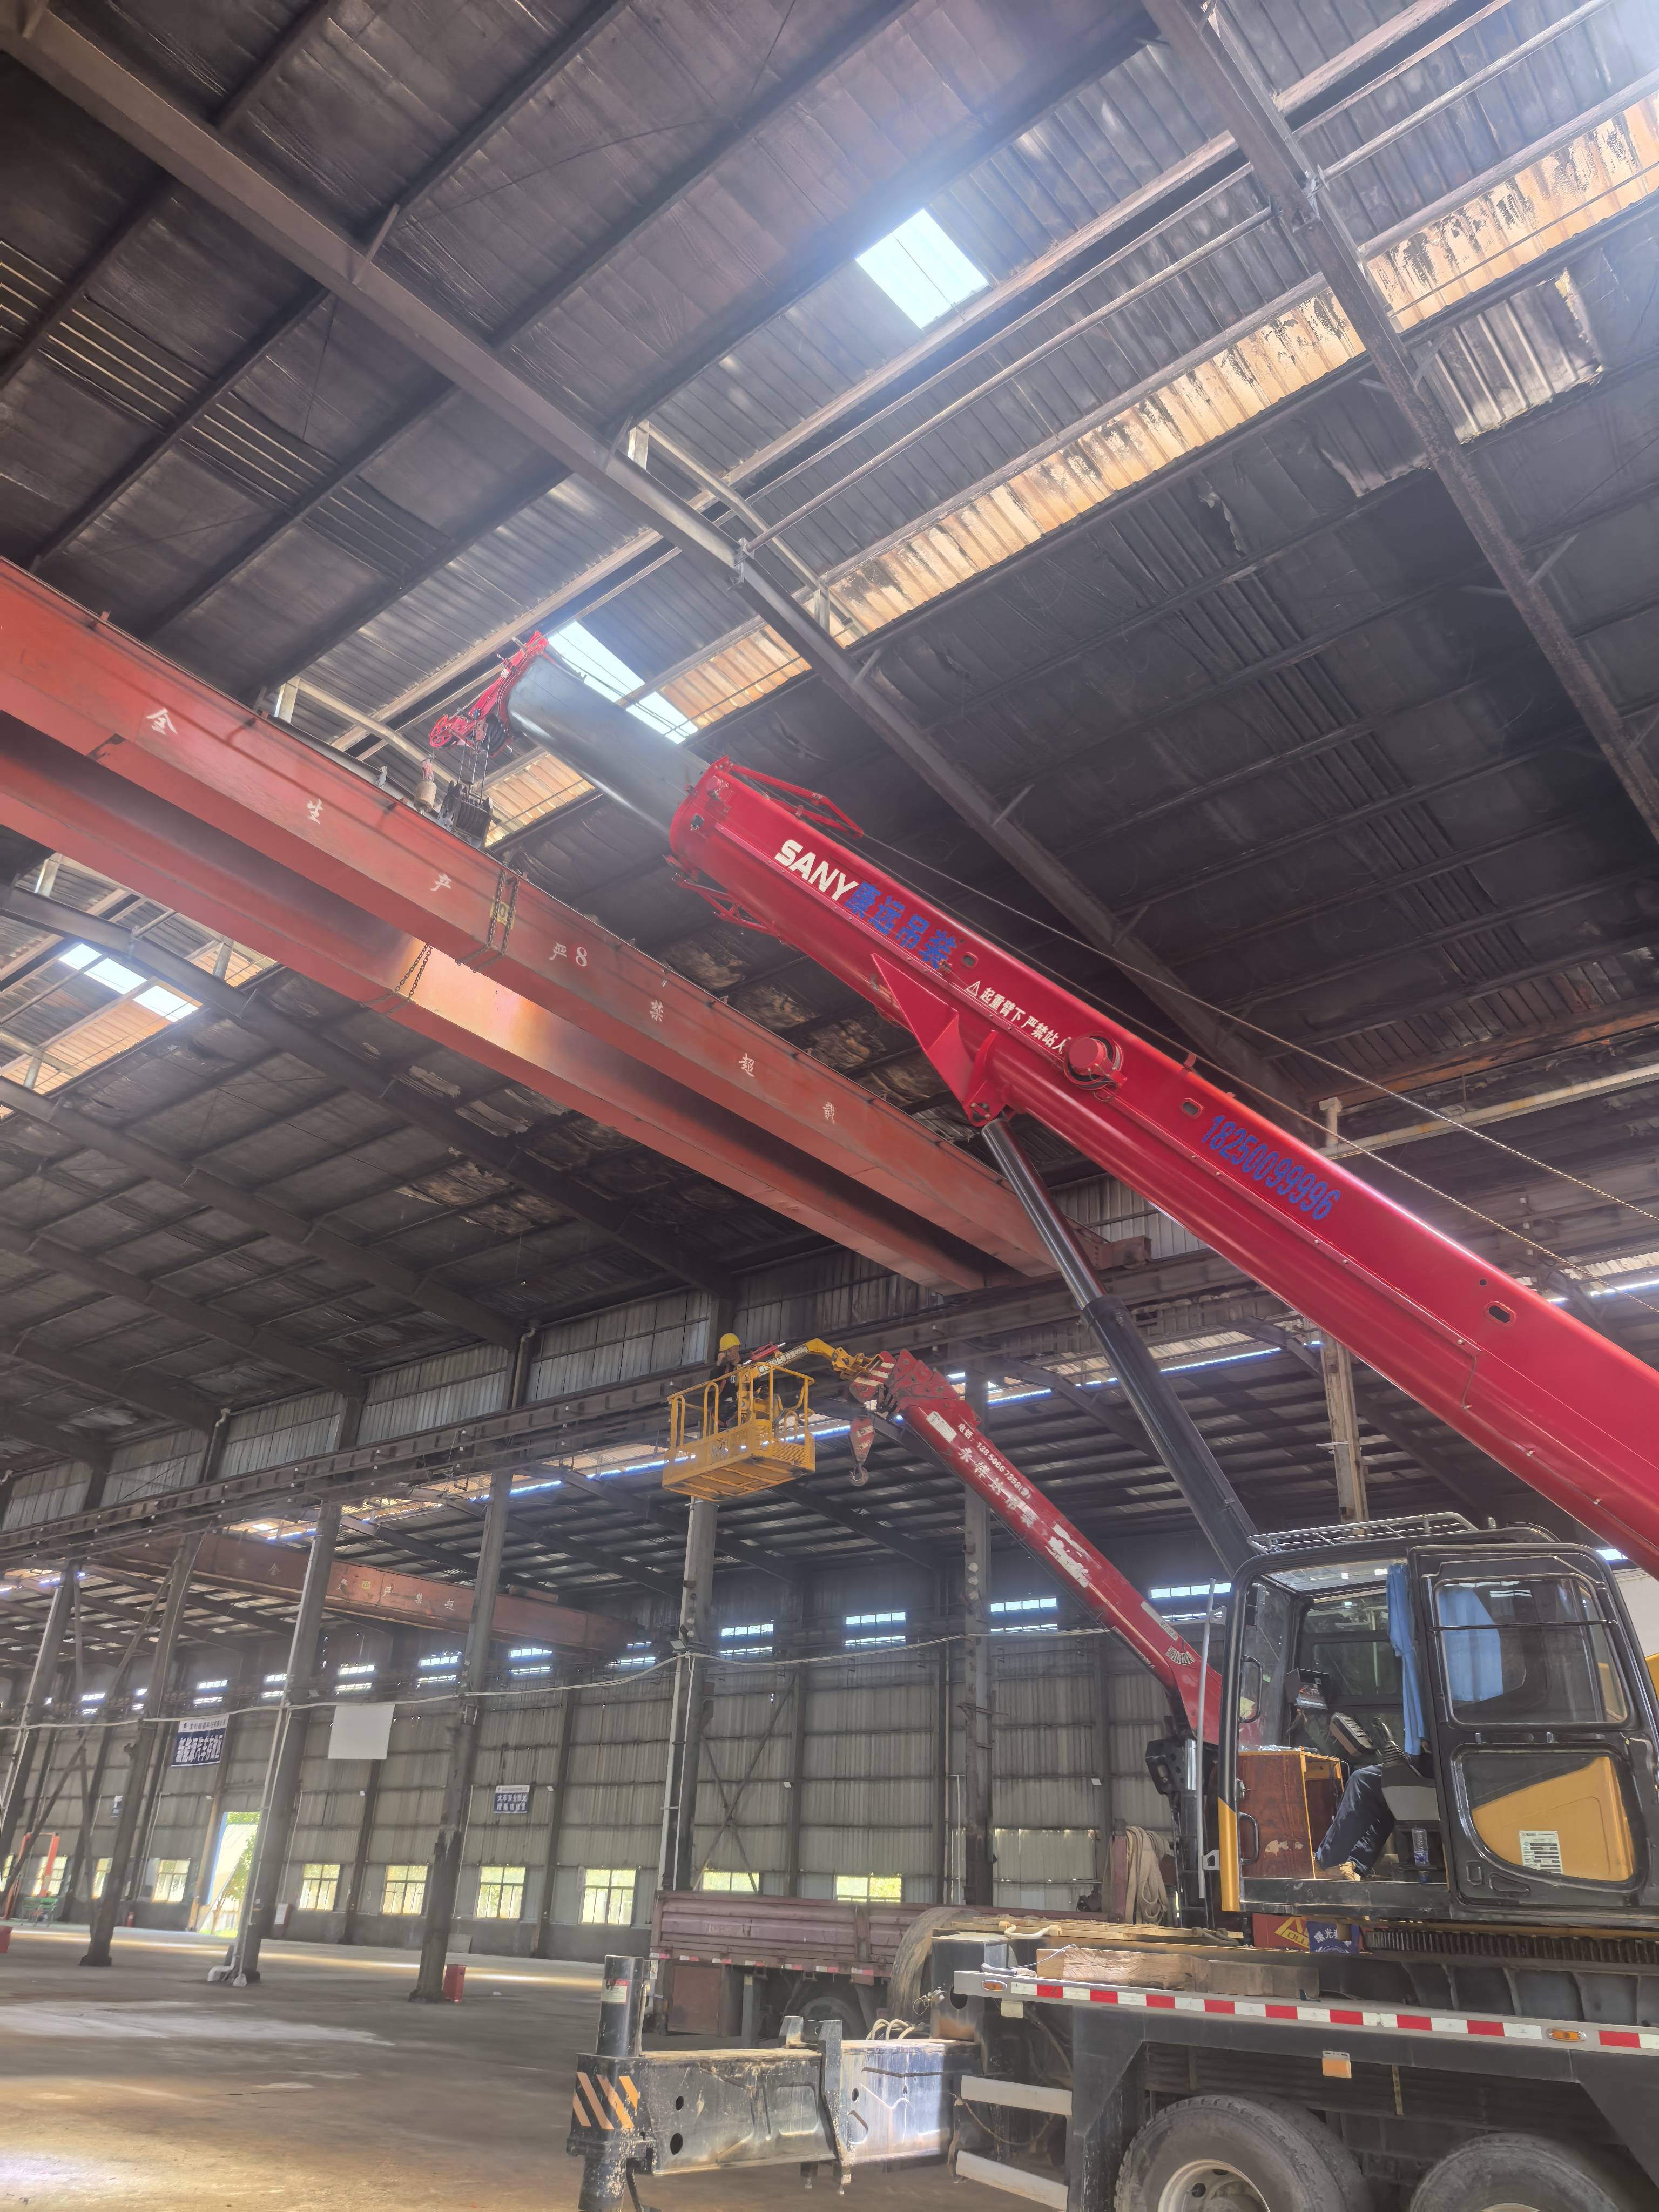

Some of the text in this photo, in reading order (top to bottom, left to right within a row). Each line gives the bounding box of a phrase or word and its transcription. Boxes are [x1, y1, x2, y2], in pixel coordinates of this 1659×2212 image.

[774, 839, 859, 901] SANY
[576, 946, 588, 967] 8
[979, 987, 1071, 1054] 起重臂下 严禁站人
[1202, 1115, 1340, 1220] 18250099996
